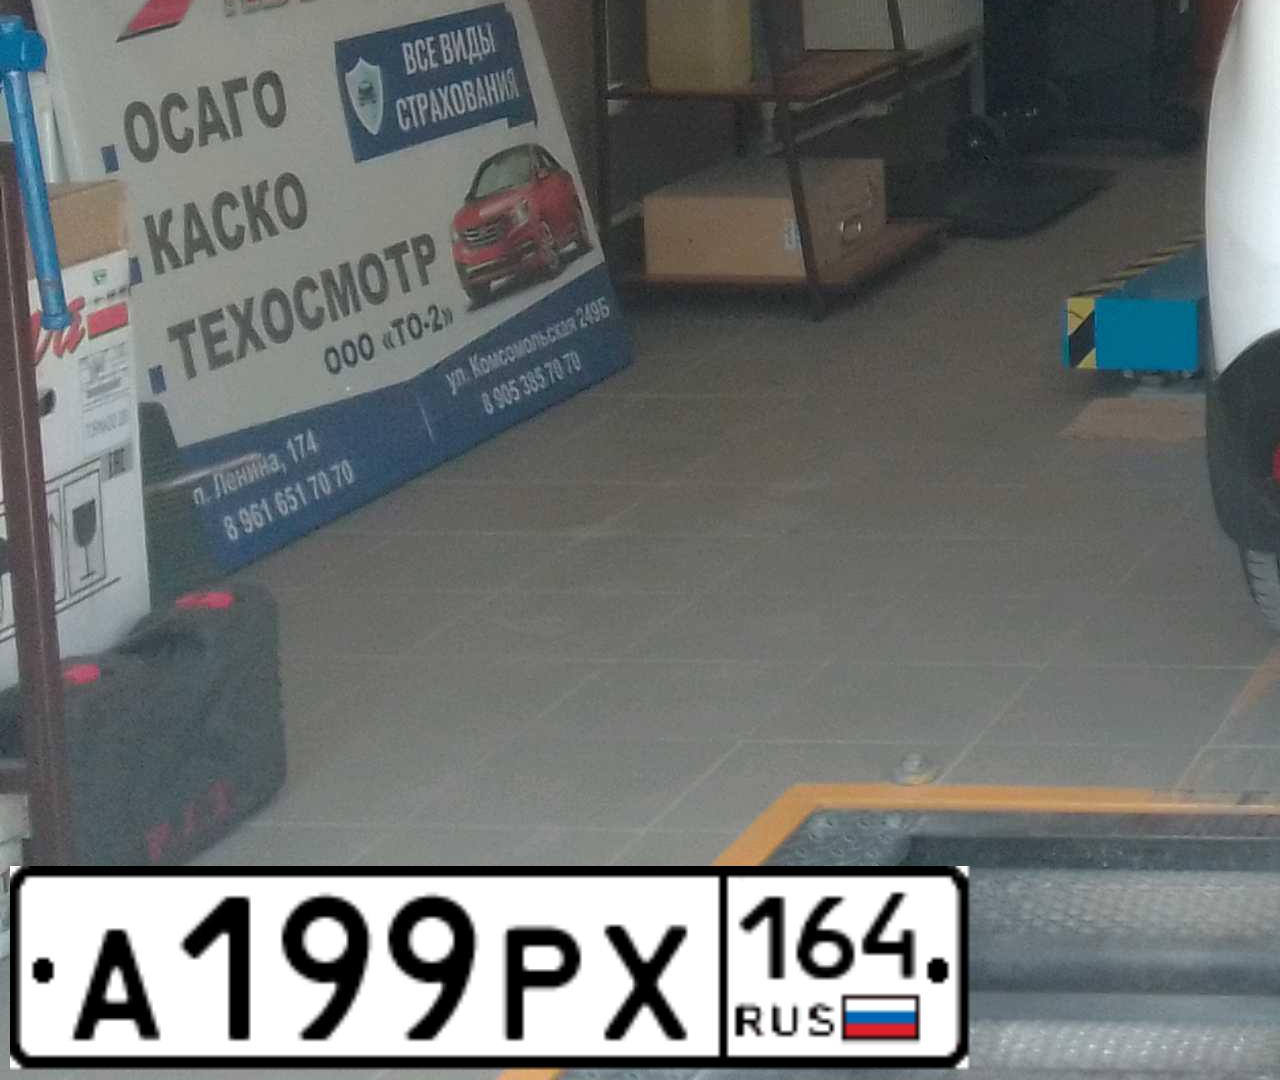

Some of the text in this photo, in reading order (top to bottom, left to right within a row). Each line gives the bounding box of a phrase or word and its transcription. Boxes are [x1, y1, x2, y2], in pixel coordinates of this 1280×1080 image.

[401, 21, 496, 76] ВСЕ ВИДЫ
[124, 69, 288, 164] ОСАГО
[396, 67, 520, 132] СТРАХОВАНИЯ
[144, 171, 309, 275] КАСКО
[167, 233, 437, 382] ТЕХОСМОТР
[468, 316, 577, 379] Комсомольская
[286, 428, 318, 464] 174
[223, 514, 239, 541] 8
[306, 471, 331, 500] 70
[329, 458, 354, 488] 70
